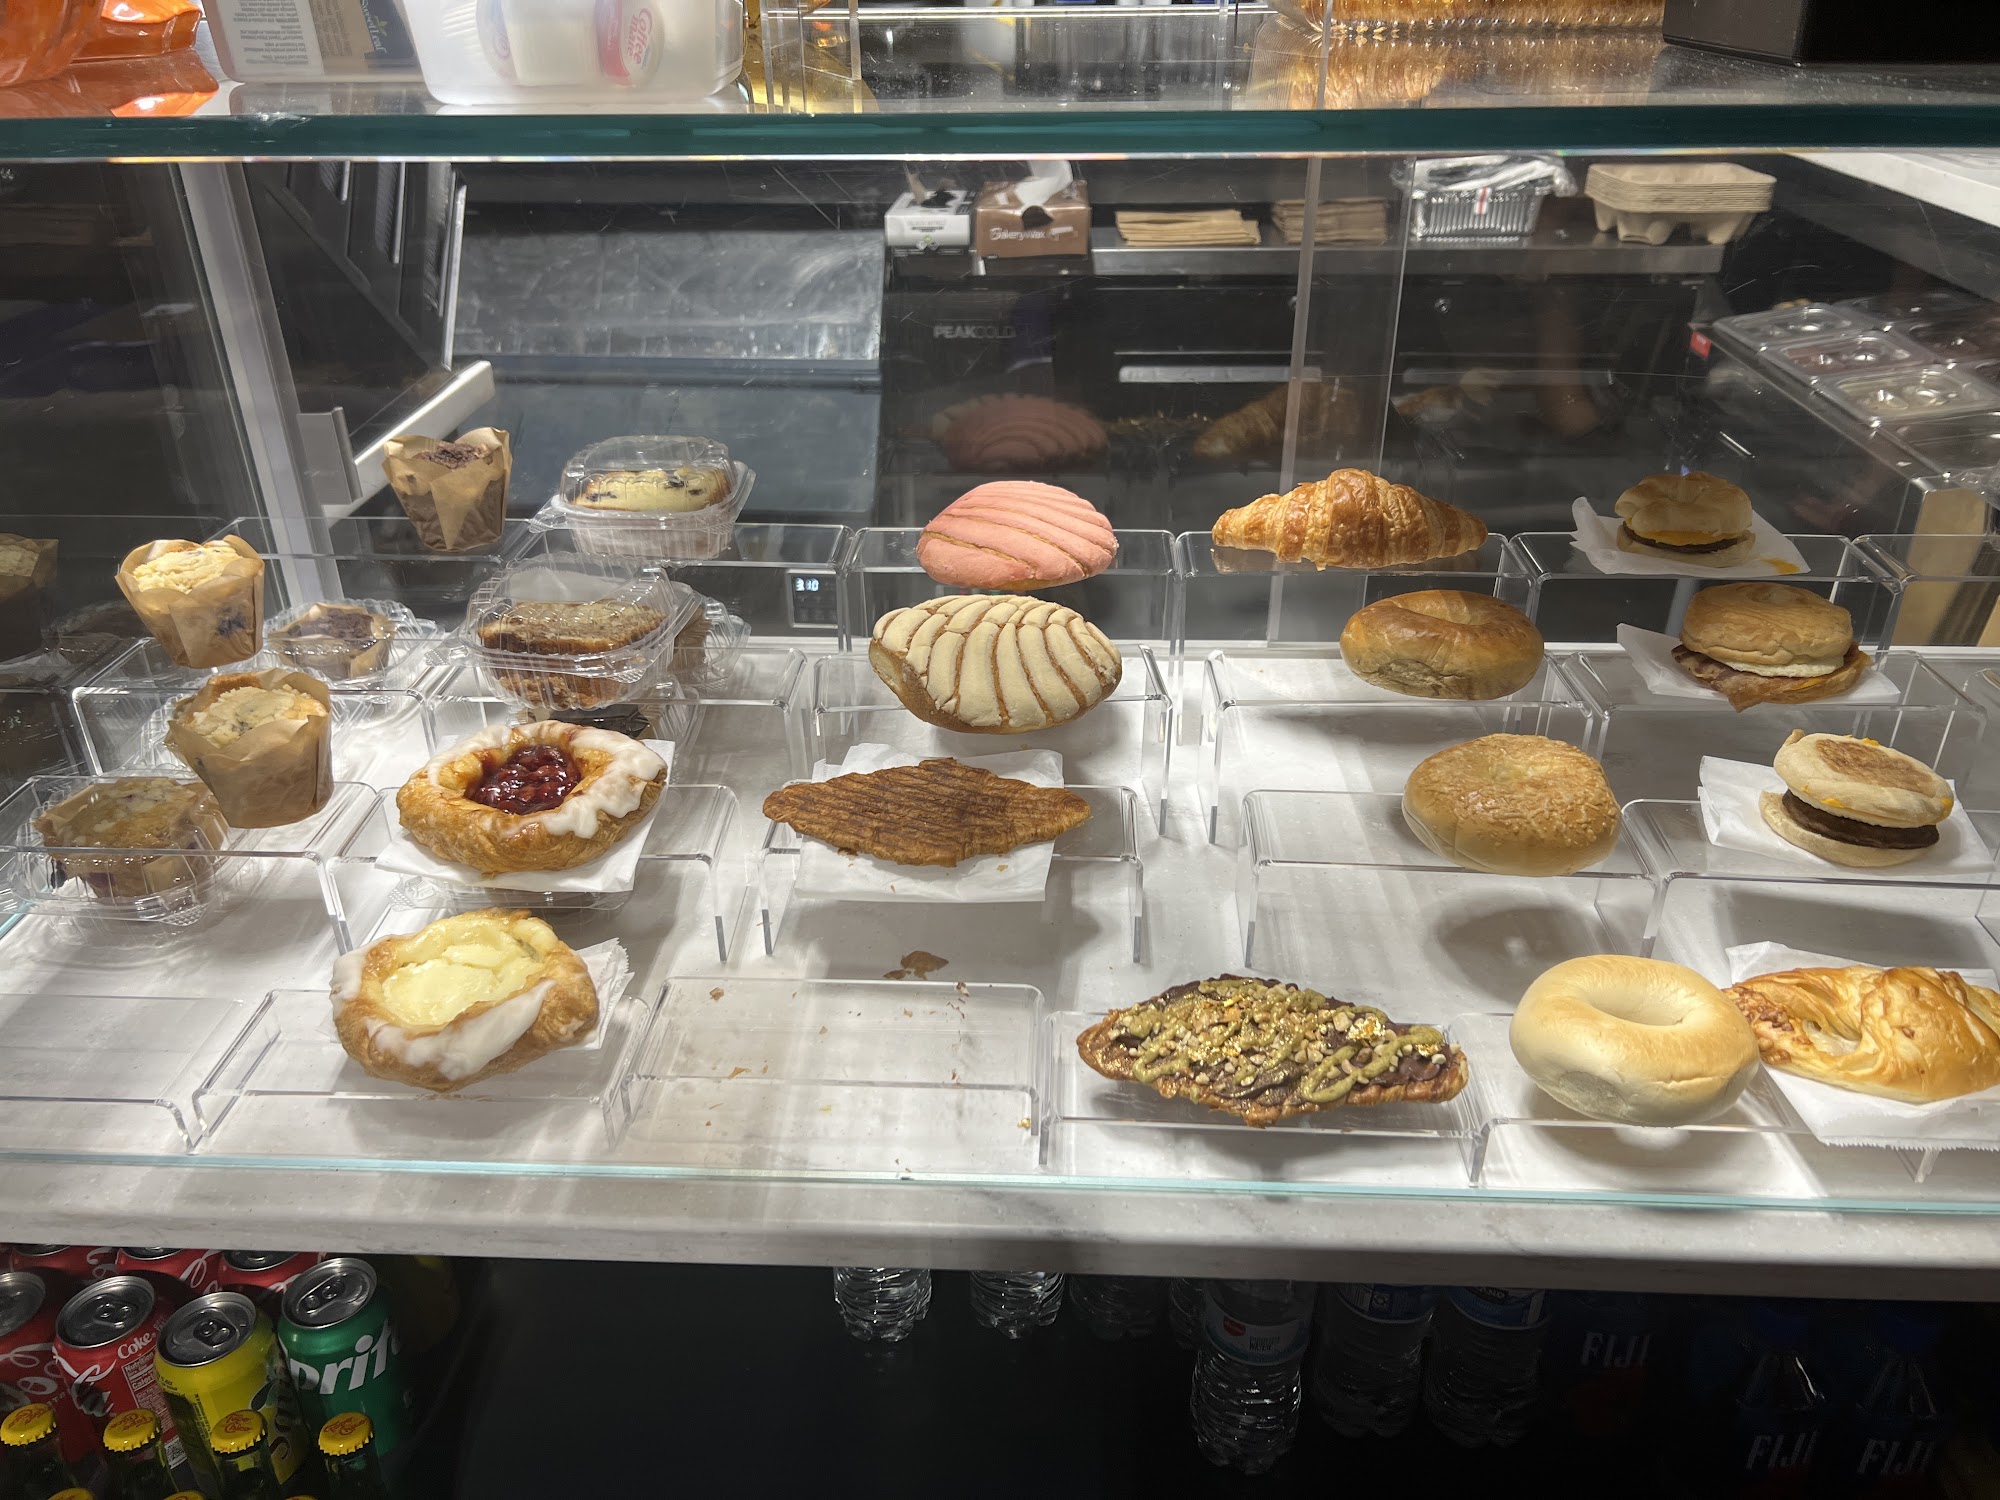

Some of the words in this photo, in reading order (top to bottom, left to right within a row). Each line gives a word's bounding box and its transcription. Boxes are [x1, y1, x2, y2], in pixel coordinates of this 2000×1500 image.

[633, 8, 653, 65] Coffee
[117, 1332, 153, 1359] Coke
[284, 1317, 399, 1396] prit
[1580, 1331, 1652, 1369] FIJI
[1745, 1428, 1820, 1471] FIJI
[1855, 1438, 1938, 1475] FIJI
